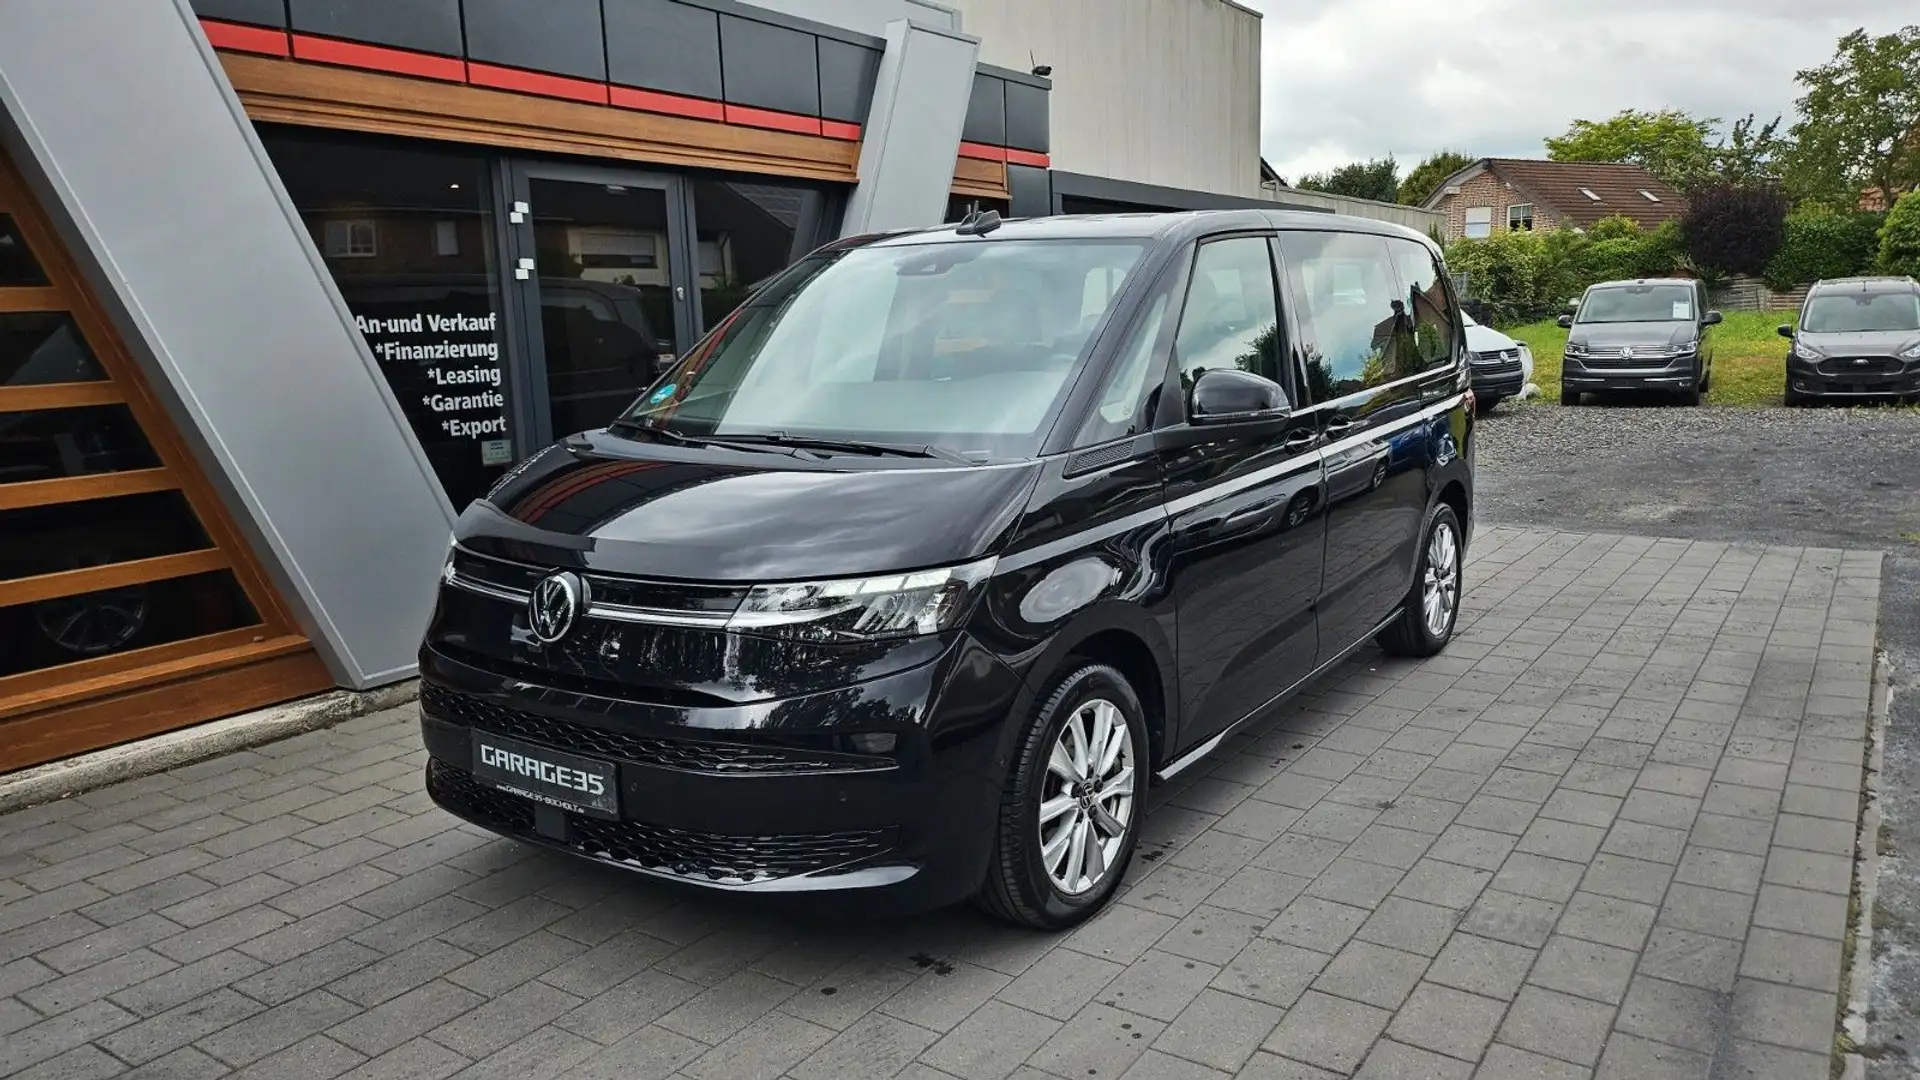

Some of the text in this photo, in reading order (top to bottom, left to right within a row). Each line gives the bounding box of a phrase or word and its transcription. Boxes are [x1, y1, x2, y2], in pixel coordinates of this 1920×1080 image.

[356, 312, 497, 334] An-und Verkauf
[480, 744, 605, 796] GARAGE35
